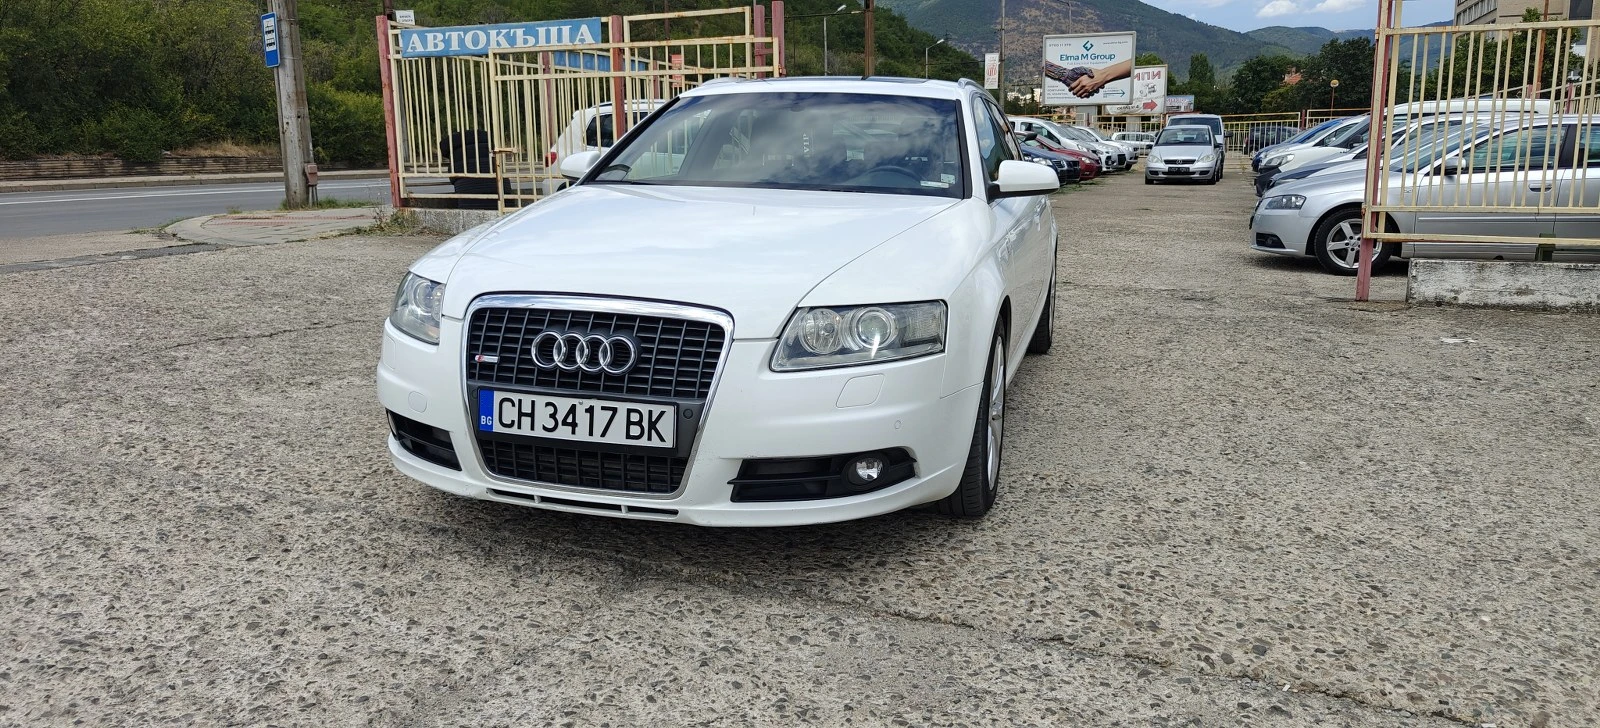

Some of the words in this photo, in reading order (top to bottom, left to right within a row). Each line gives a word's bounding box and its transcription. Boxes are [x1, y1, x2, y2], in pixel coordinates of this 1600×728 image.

[1090, 53, 1116, 62] Group
[480, 416, 492, 426] BG
[498, 398, 536, 431] CH
[542, 402, 618, 438] 3417
[626, 408, 667, 442] BK
